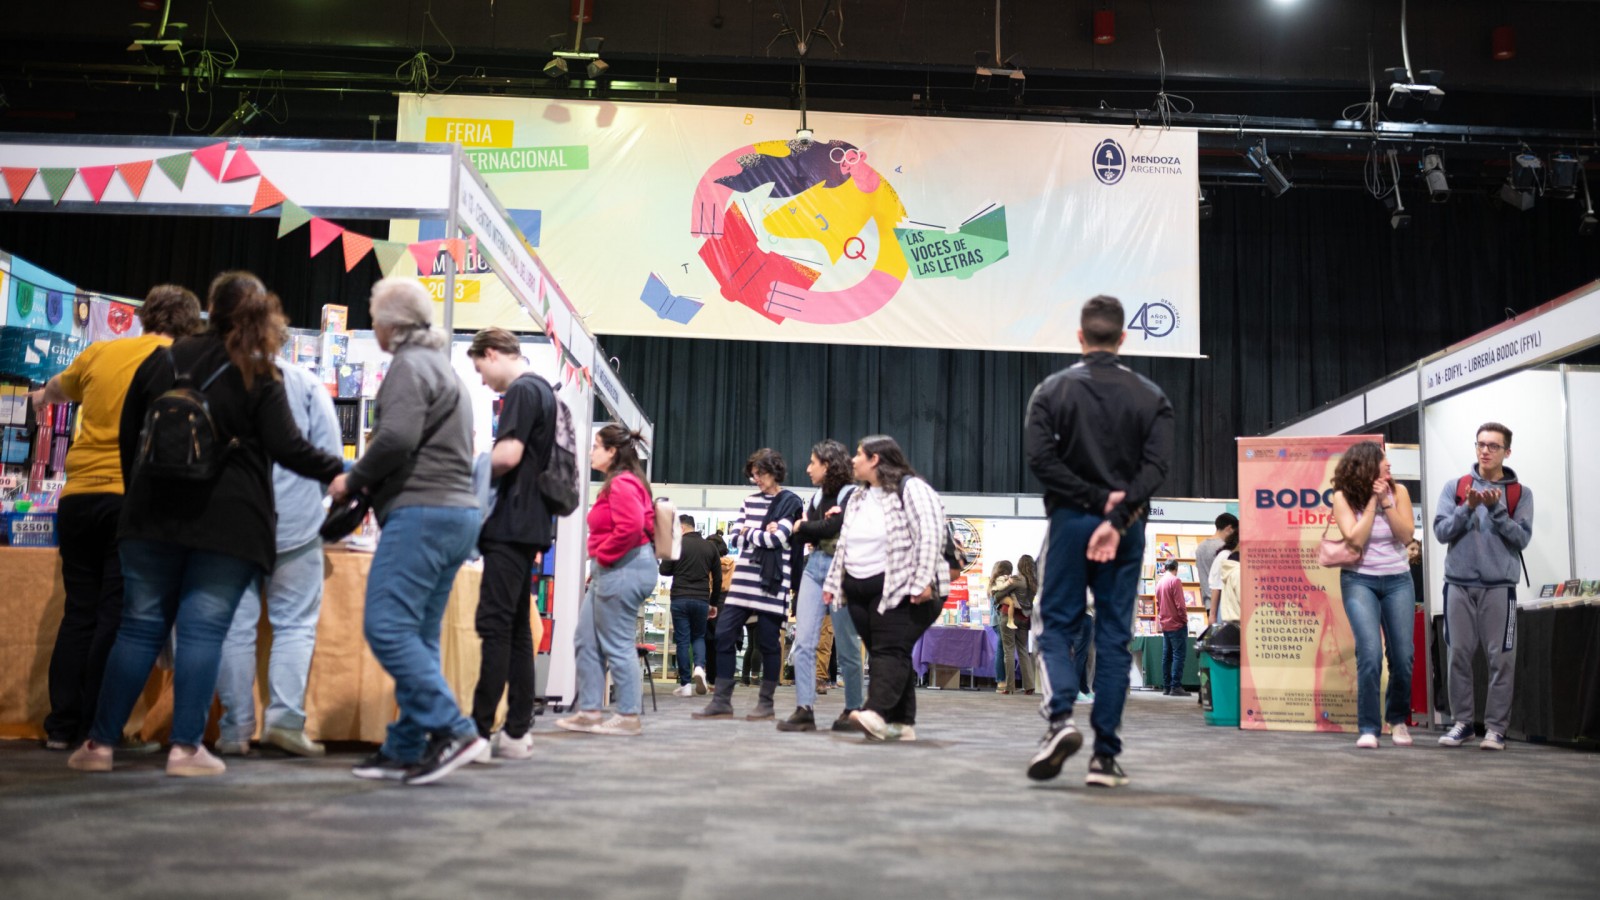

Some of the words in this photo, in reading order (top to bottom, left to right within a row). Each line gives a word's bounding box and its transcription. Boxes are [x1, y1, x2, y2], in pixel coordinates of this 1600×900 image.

[744, 114, 754, 125] B
[446, 122, 493, 143] FERIA
[466, 150, 567, 170] ERNACIONAL
[1132, 156, 1181, 165] MENDOZA
[1131, 166, 1182, 175] ARGENTINA
[844, 236, 867, 261] Q
[906, 232, 925, 246] LAS
[911, 240, 951, 262] VOCES
[954, 239, 967, 252] DE
[917, 261, 936, 275] LAS
[937, 249, 984, 273] LETRAS
[428, 281, 465, 300] 203
[1127, 302, 1175, 341] 40
[1161, 298, 1180, 329] DEMOCRACIA
[1468, 347, 1495, 372] LIBRERÍA
[1497, 340, 1519, 362] BODOC
[1520, 330, 1541, 354] (FFYL)
[1150, 506, 1164, 516] ERÍA
[16, 523, 50, 532] $2500
[1261, 584, 1326, 592] ARQUEOLOGÍA
